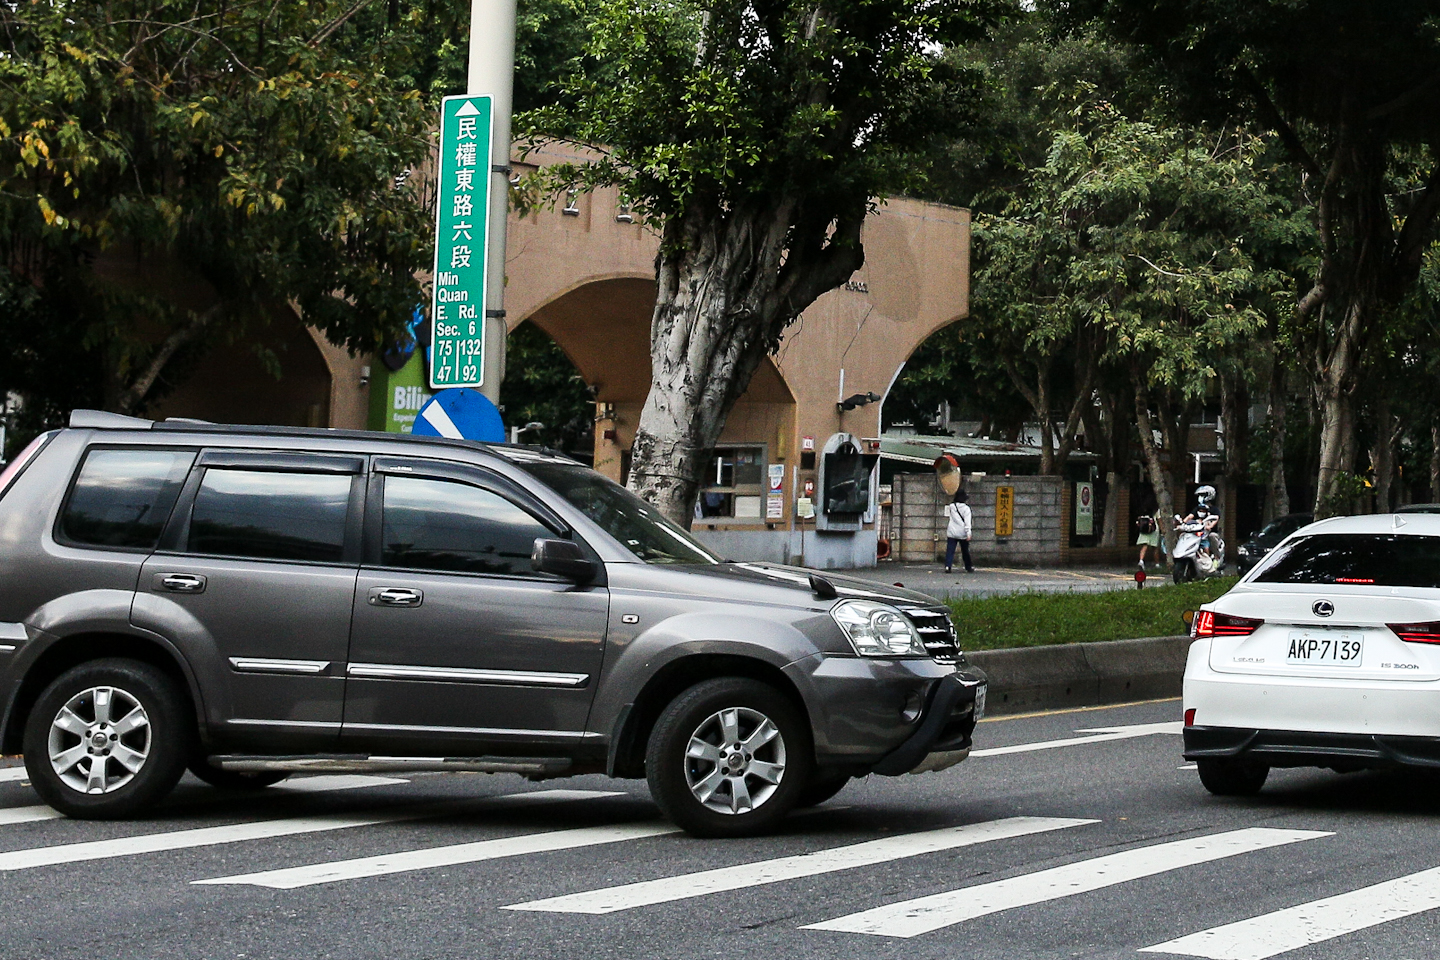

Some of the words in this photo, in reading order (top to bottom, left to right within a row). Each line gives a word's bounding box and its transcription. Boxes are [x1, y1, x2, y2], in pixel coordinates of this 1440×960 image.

[450, 117, 478, 269] 民權東路六段
[438, 272, 459, 287] Min
[438, 288, 468, 304] Quan
[437, 306, 449, 321] E.
[459, 304, 478, 319] Rd.
[437, 322, 461, 337] Sec.
[468, 321, 476, 336] 6
[438, 340, 453, 356] 75
[460, 339, 481, 355] 132
[437, 366, 452, 382] 47
[462, 365, 477, 381] 92
